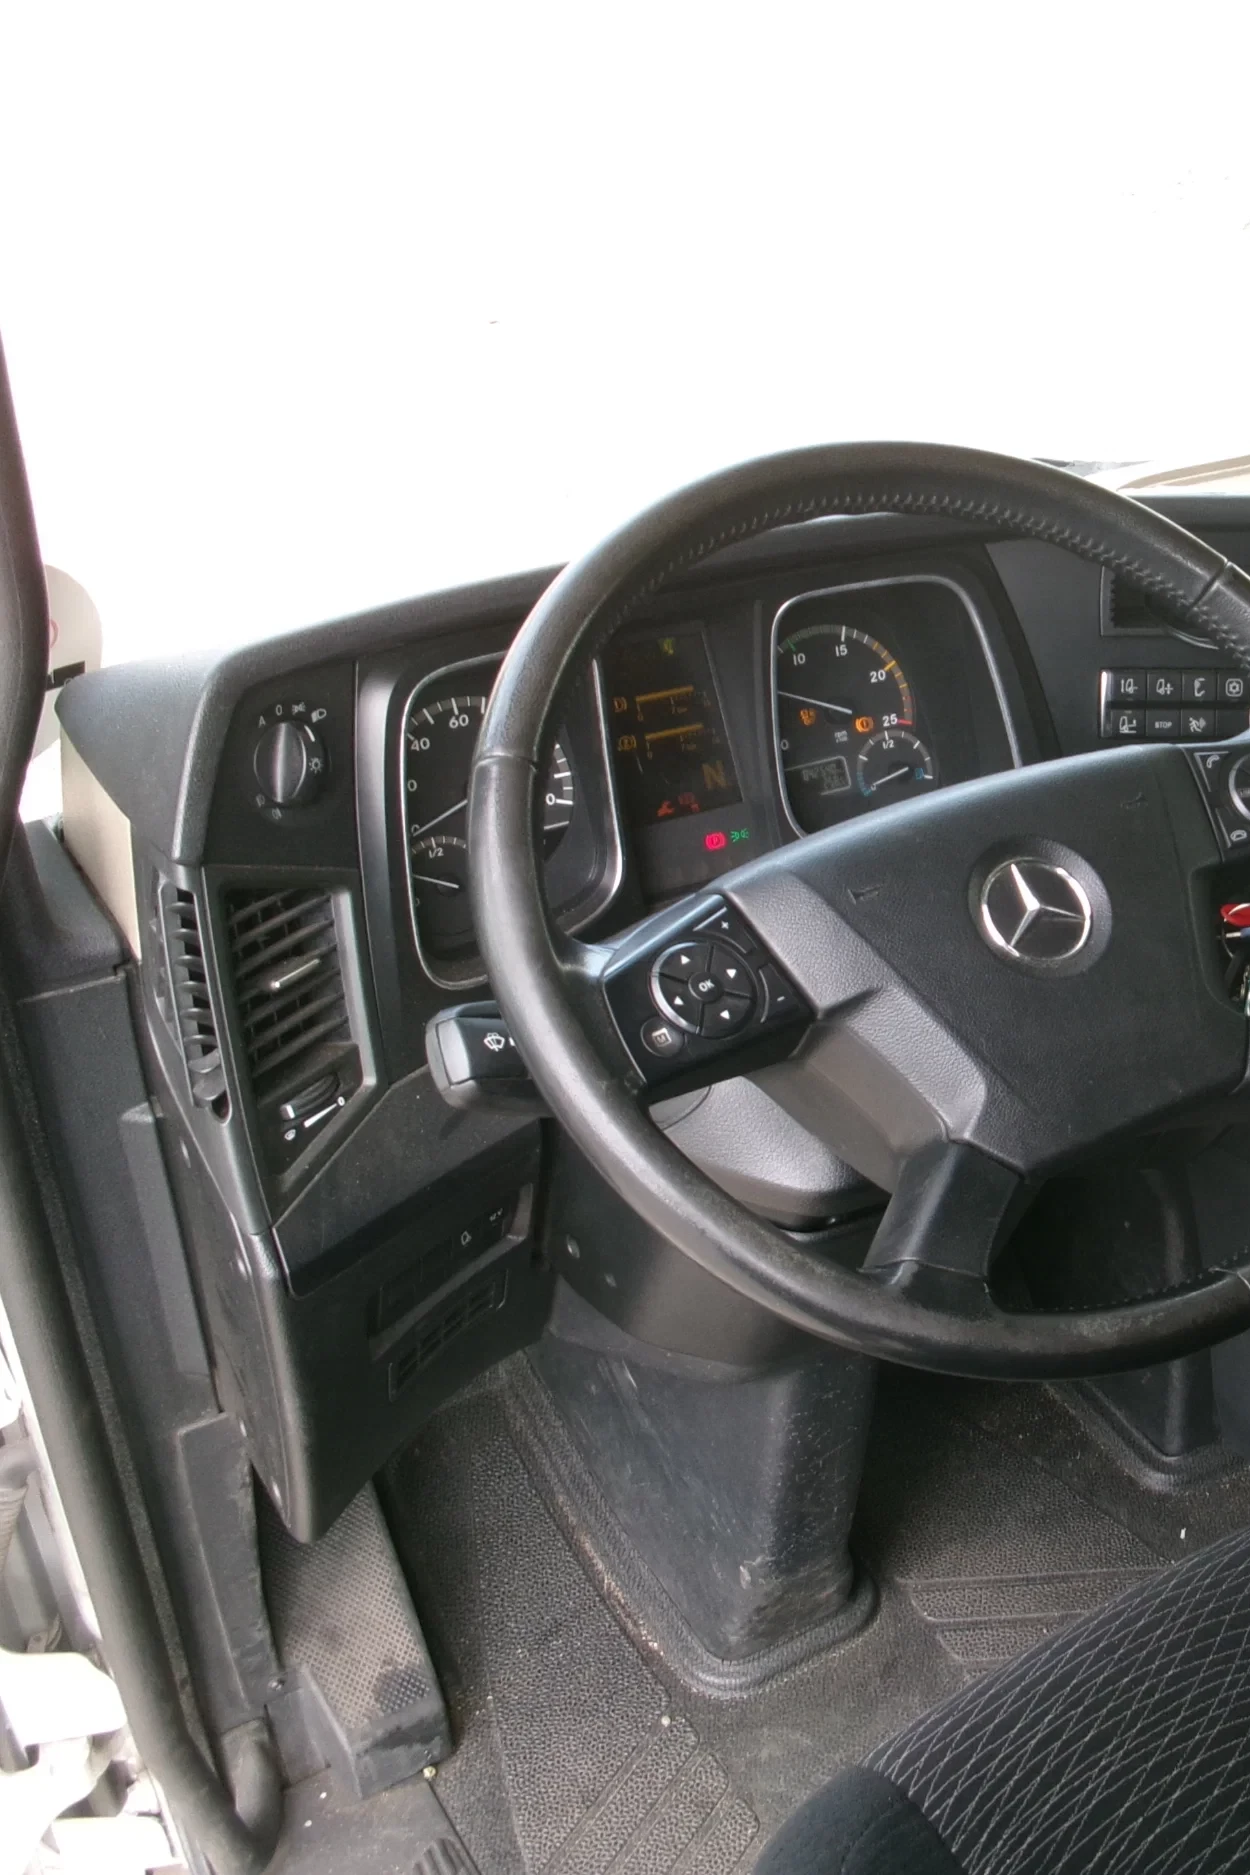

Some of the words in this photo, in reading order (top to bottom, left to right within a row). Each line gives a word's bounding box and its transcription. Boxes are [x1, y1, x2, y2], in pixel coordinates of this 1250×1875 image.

[834, 644, 849, 657] 15
[793, 652, 806, 666] 10
[869, 669, 886, 684] 20
[258, 714, 267, 729] A
[448, 714, 470, 729] 60
[882, 713, 898, 728] 25
[1154, 720, 1173, 730] STOP
[834, 730, 848, 740] rpm
[410, 736, 431, 752] 40
[882, 740, 895, 750] 1/2
[702, 759, 730, 791] N
[428, 847, 445, 859] 1/2
[697, 980, 716, 993] OK
